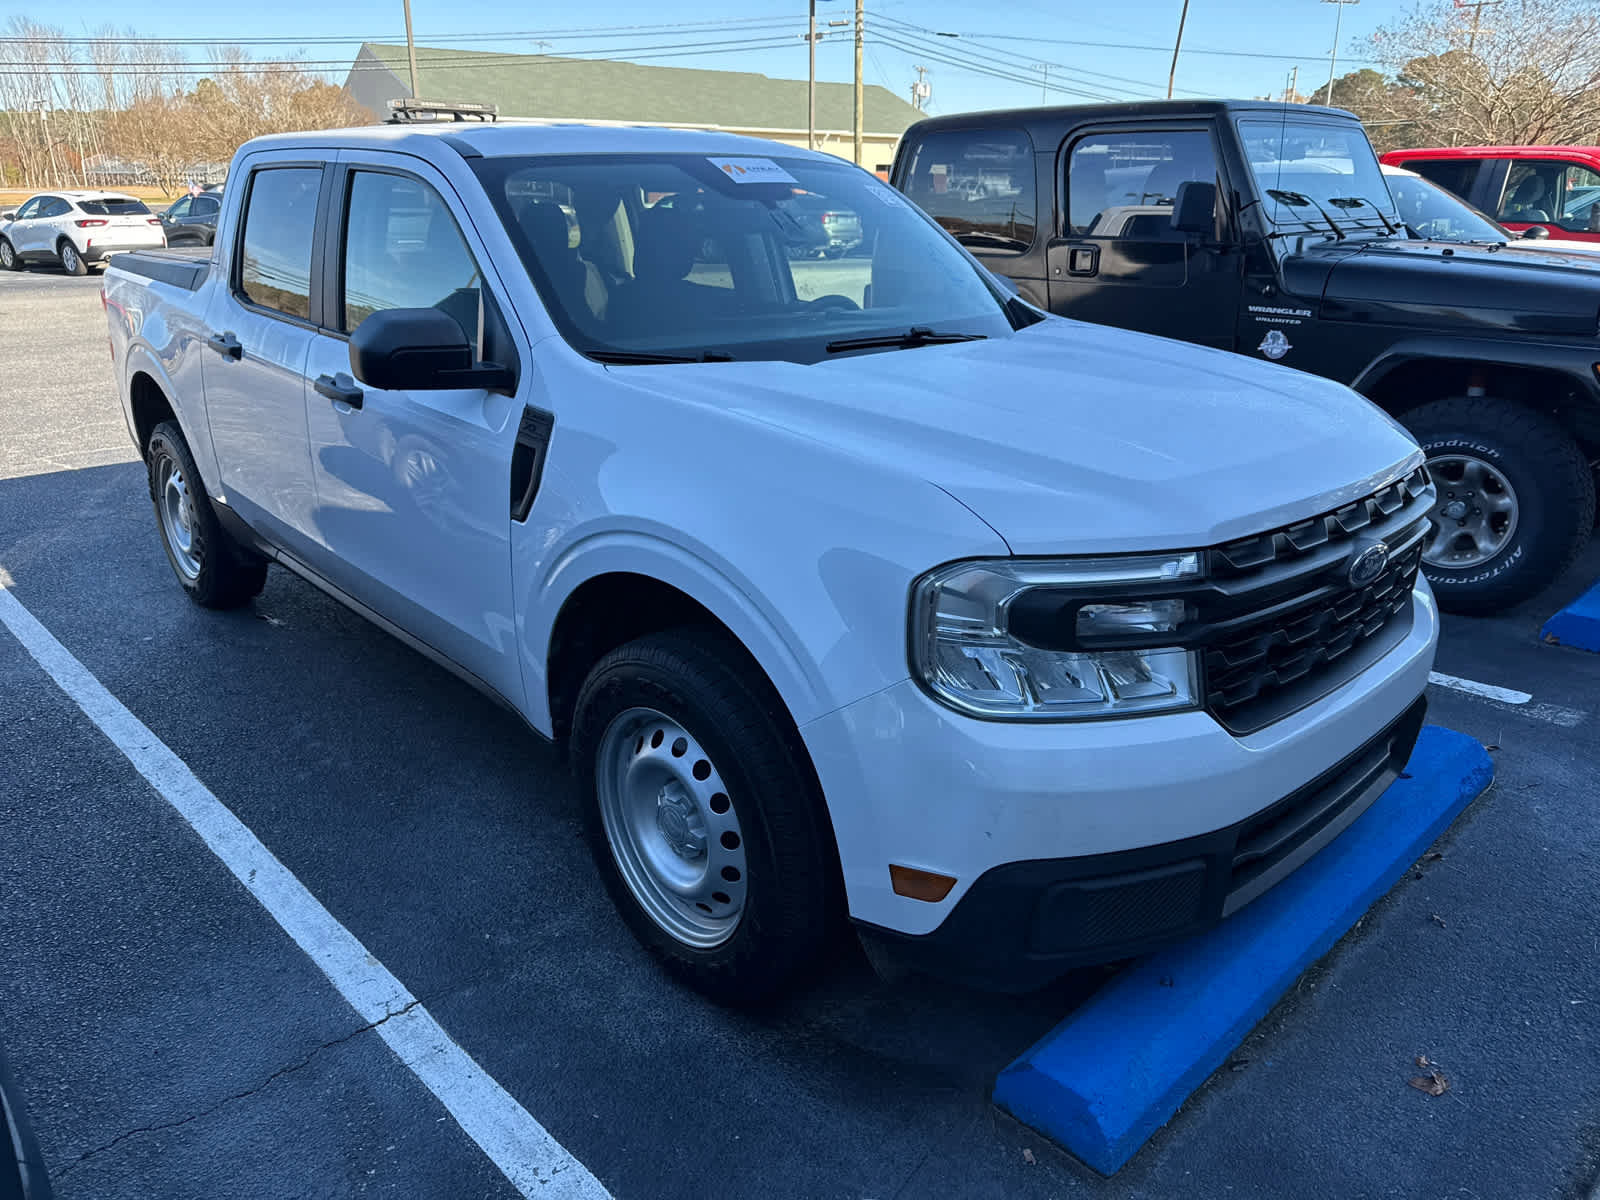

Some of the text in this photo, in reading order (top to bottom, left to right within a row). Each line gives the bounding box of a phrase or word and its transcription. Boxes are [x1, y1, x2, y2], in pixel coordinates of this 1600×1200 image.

[1248, 305, 1312, 317] WRANGLER
[1255, 316, 1302, 325] UNLIMITED
[1422, 439, 1500, 458] oodrich
[1426, 544, 1522, 584] All-Terrain
